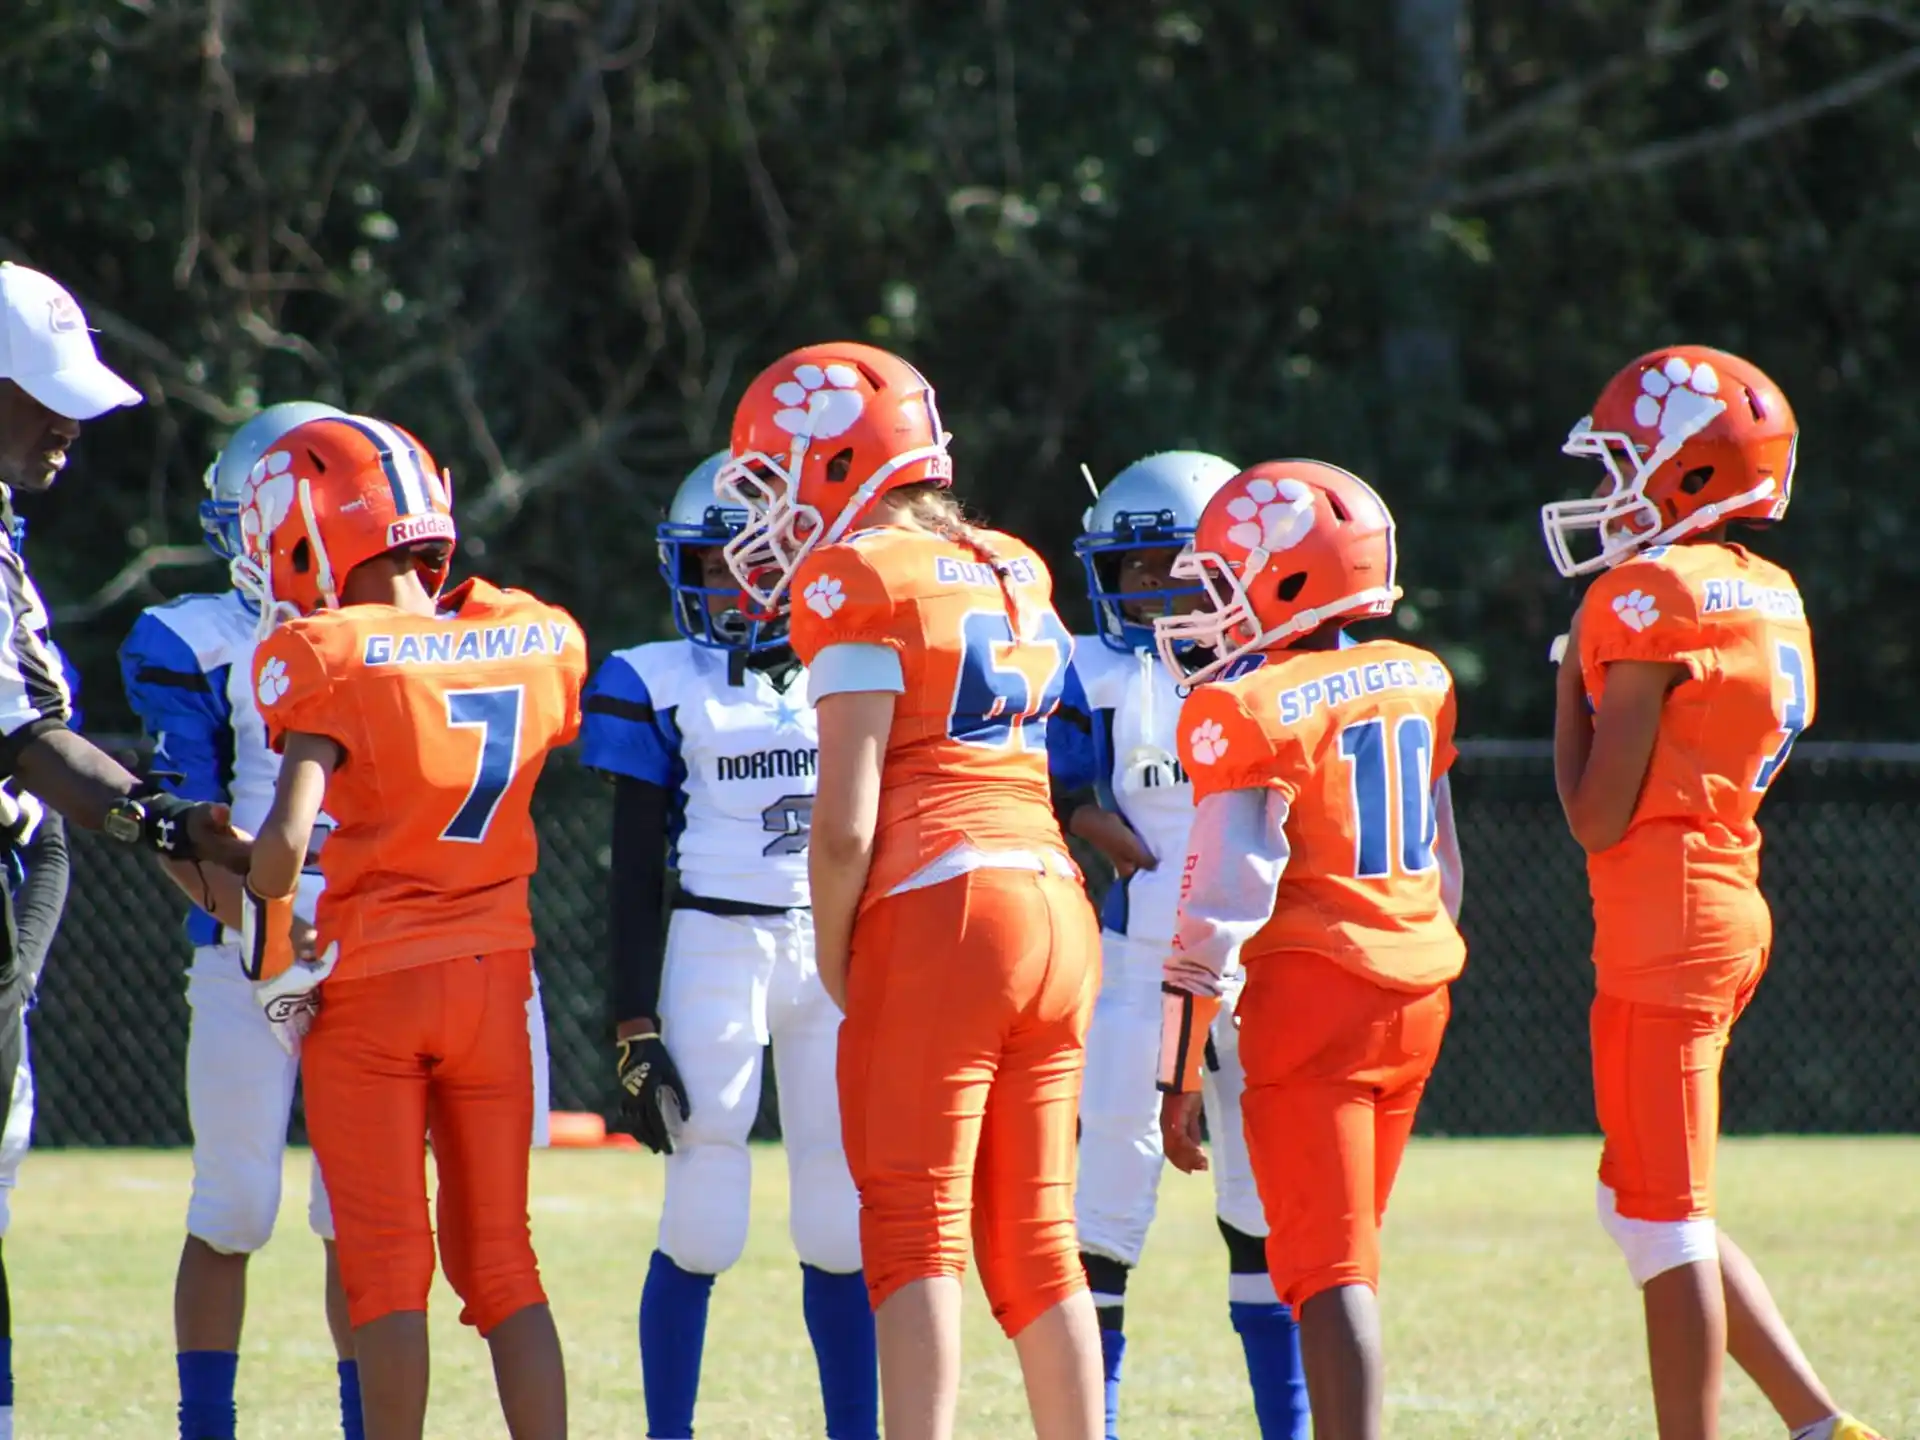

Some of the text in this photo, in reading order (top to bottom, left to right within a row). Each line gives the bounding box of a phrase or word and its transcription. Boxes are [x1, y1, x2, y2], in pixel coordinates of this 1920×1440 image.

[364, 619, 568, 666] GANAWAY
[1279, 660, 1418, 726] SPRIGGS
[437, 684, 525, 844] 7
[1337, 715, 1440, 880] 10
